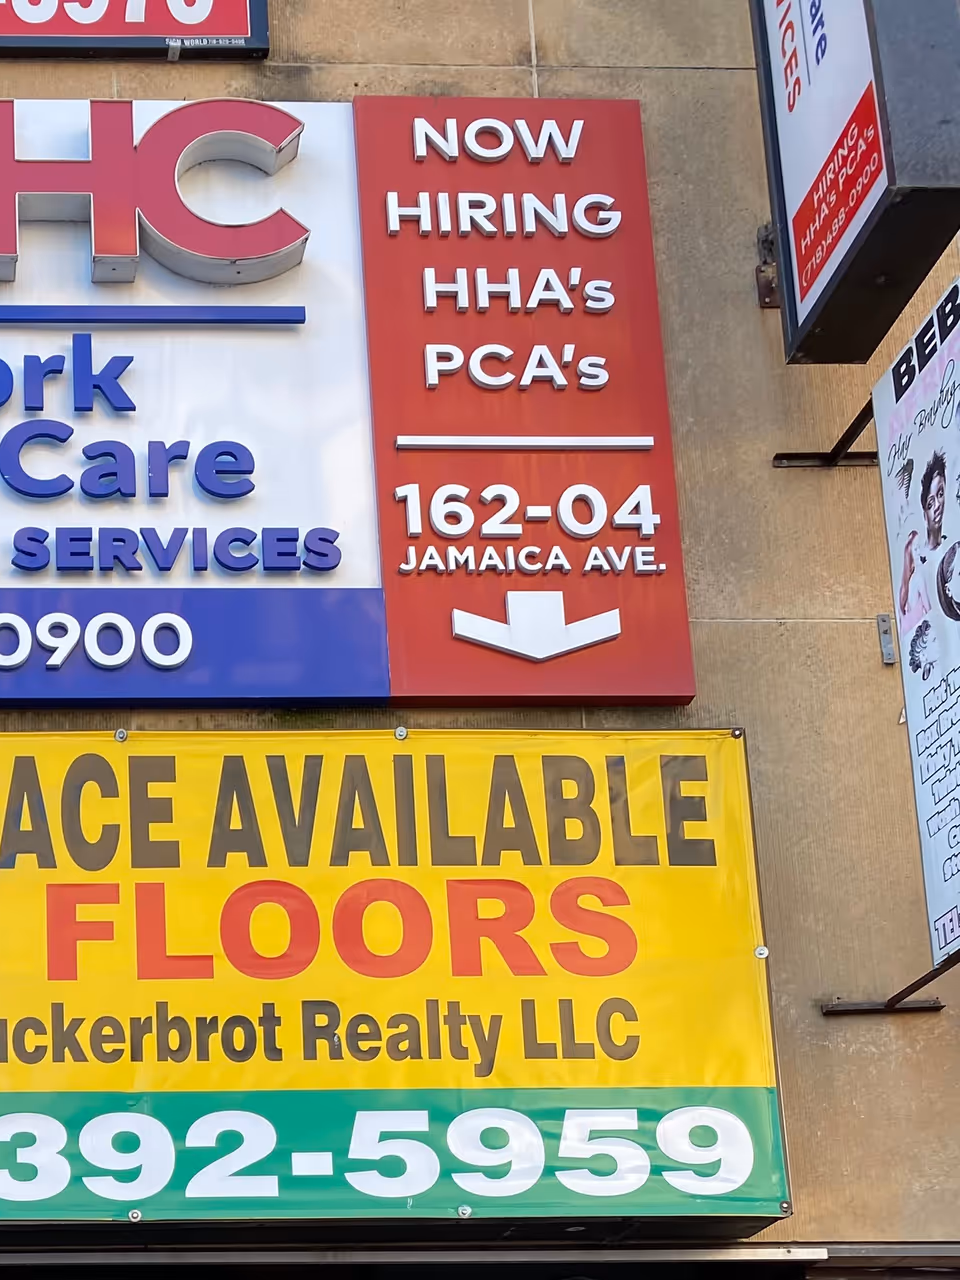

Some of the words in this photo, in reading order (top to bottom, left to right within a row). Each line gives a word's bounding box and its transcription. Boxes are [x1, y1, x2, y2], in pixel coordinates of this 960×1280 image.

[183, 38, 208, 46] WORLD
[413, 117, 585, 162] NOW
[813, 122, 858, 208] HIRING
[387, 191, 622, 238] HIRING
[801, 190, 837, 255] HHA's
[839, 124, 875, 193] PCA's
[802, 152, 879, 287] (718)488-0900
[423, 267, 616, 313] HHA's
[425, 343, 610, 390] PCA's
[395, 484, 661, 539] 162-04
[11, 526, 342, 572] SERVICES
[399, 545, 572, 575] JAMAICA
[584, 546, 668, 575] AVE.
[206, 754, 719, 868] AVAILABLE
[46, 877, 638, 982] FLOORS
[301, 999, 502, 1078] Realty
[520, 997, 640, 1062] LLC
